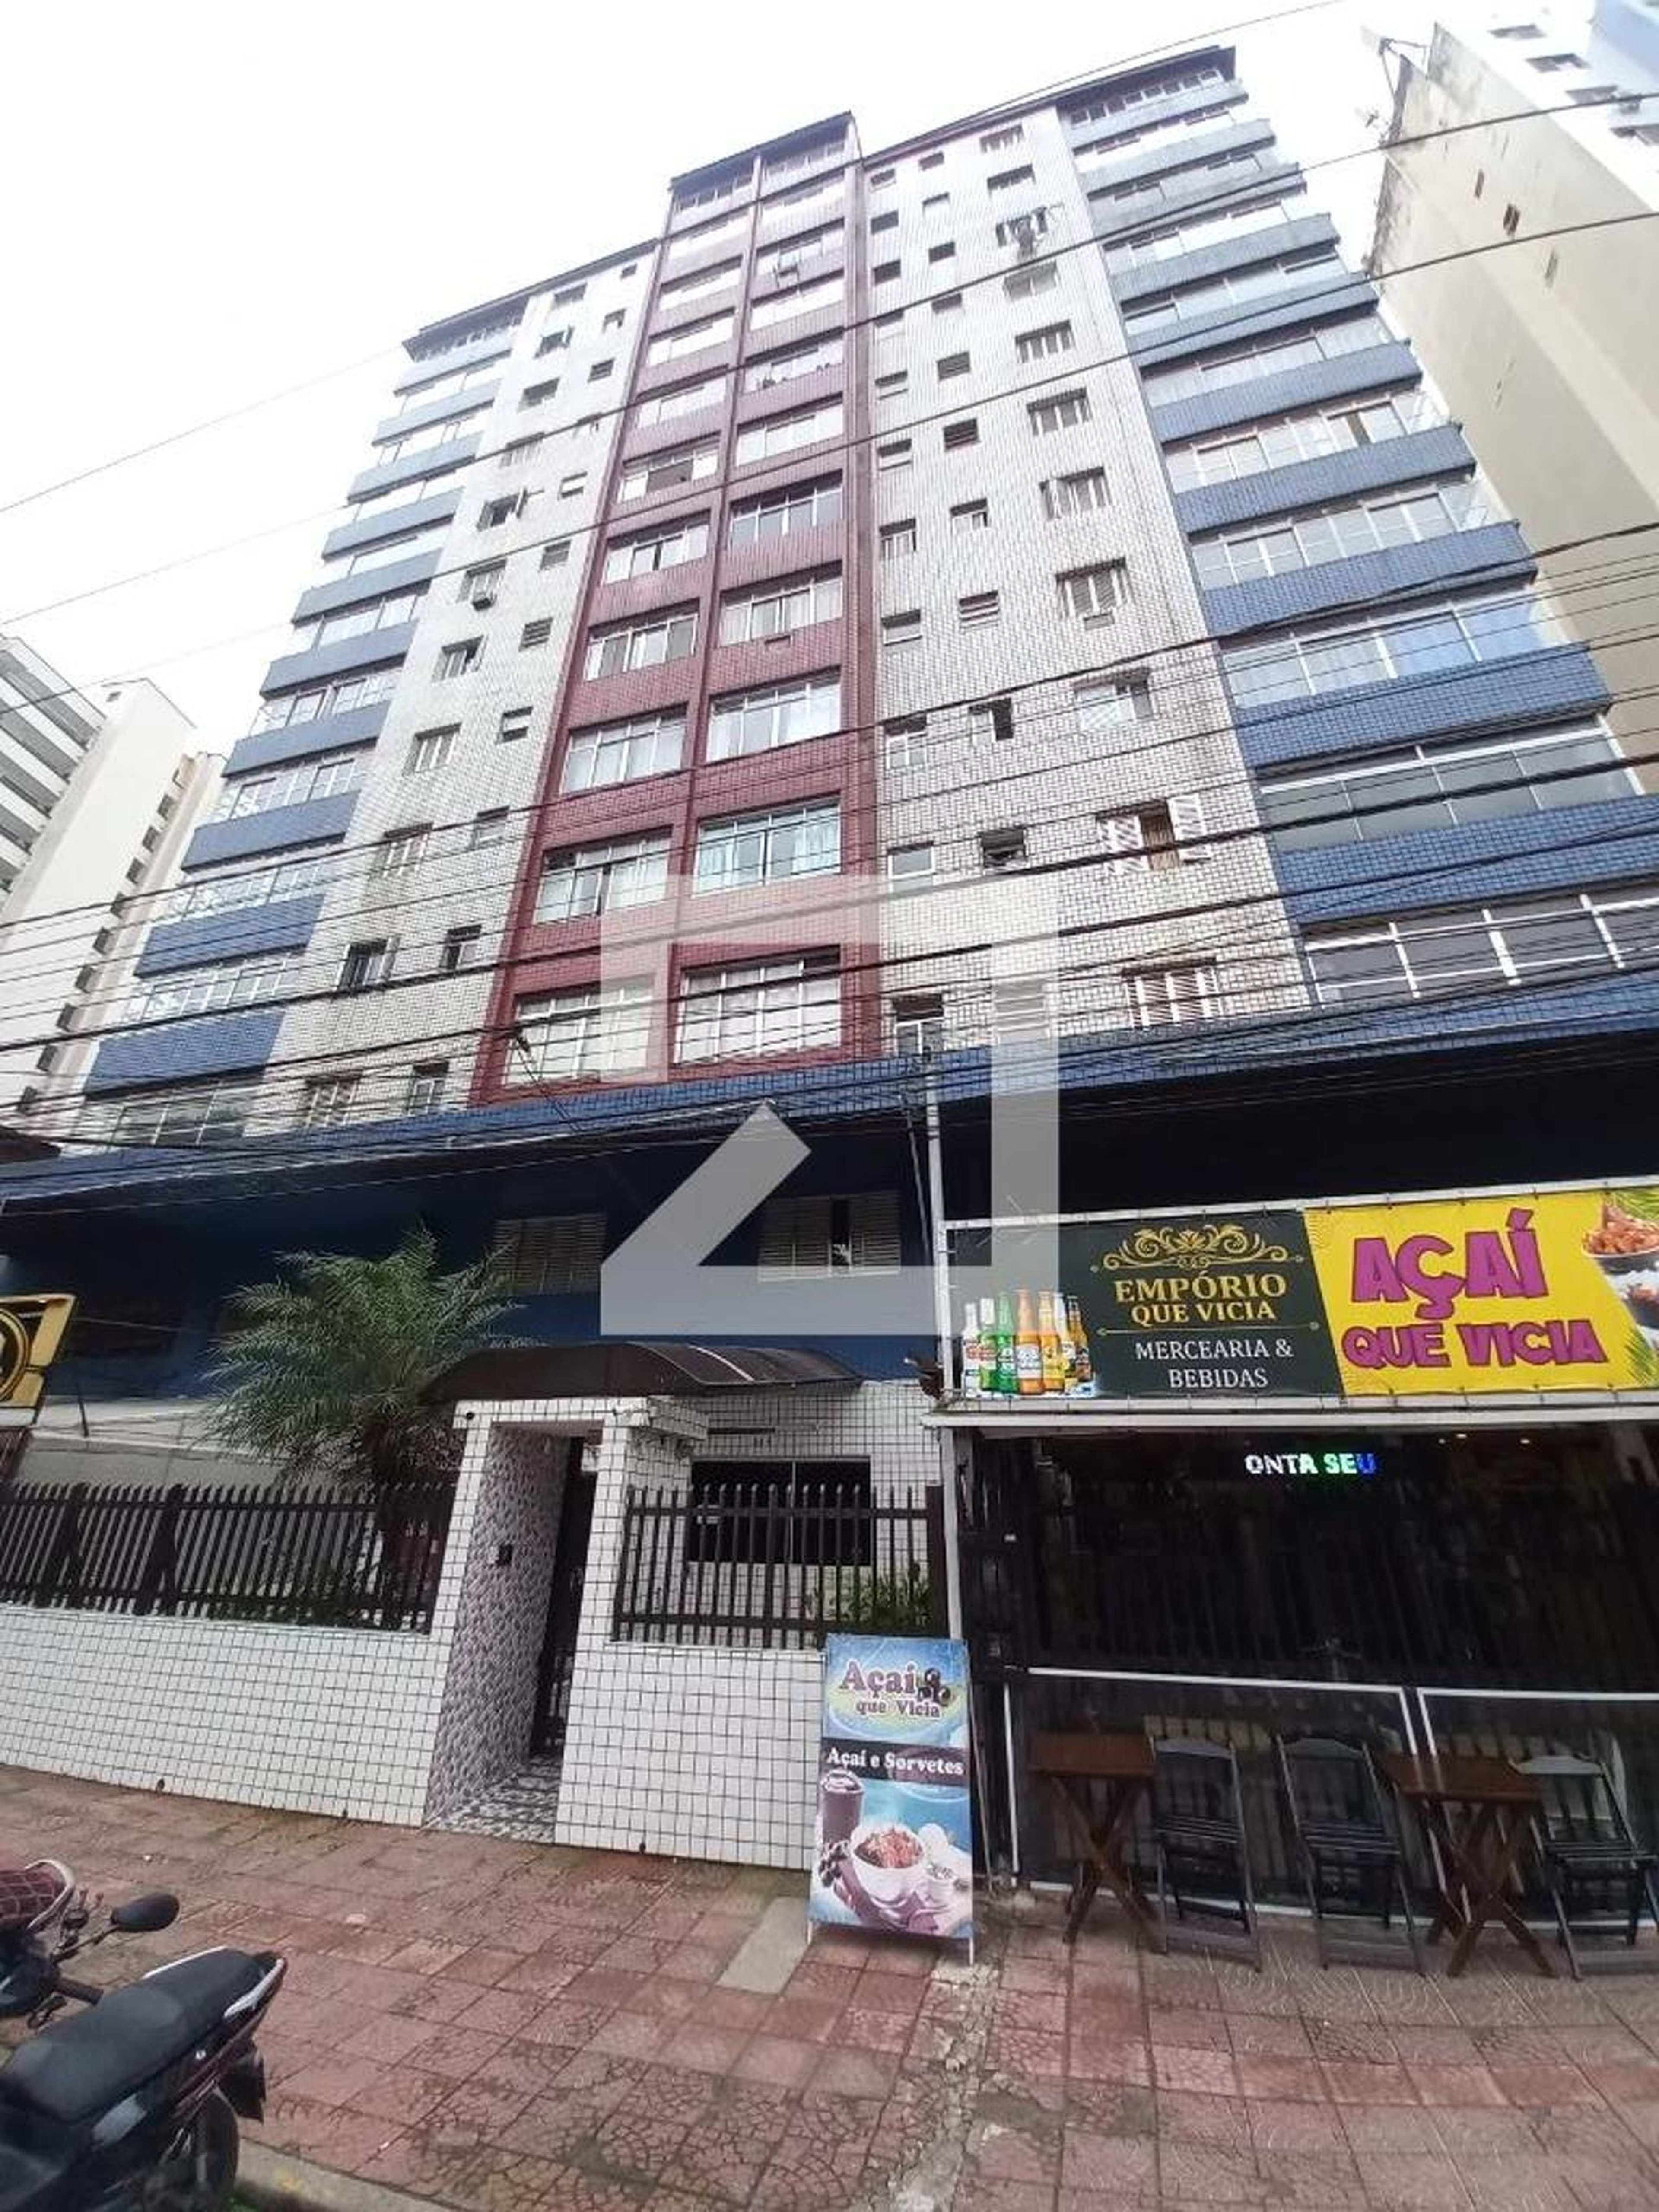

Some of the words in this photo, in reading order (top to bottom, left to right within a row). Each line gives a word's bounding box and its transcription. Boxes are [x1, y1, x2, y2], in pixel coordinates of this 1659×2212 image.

[1351, 1207, 1549, 1319] AÇAÍ
[1114, 1270, 1287, 1303] EMPÓRIO
[1131, 1303, 1189, 1327] QUE
[1196, 1300, 1277, 1321] VICIA
[1135, 1339, 1270, 1360] MERCEARIA
[1275, 1339, 1294, 1357] &
[1341, 1323, 1452, 1369] QUE
[1456, 1320, 1609, 1367] VICIA
[1168, 1368, 1268, 1388] BEBIDAS
[1323, 1453, 1376, 1474] SEU
[856, 1701, 887, 1715] que
[870, 1754, 880, 1768] e
[884, 1752, 964, 1775] Sorvetes
